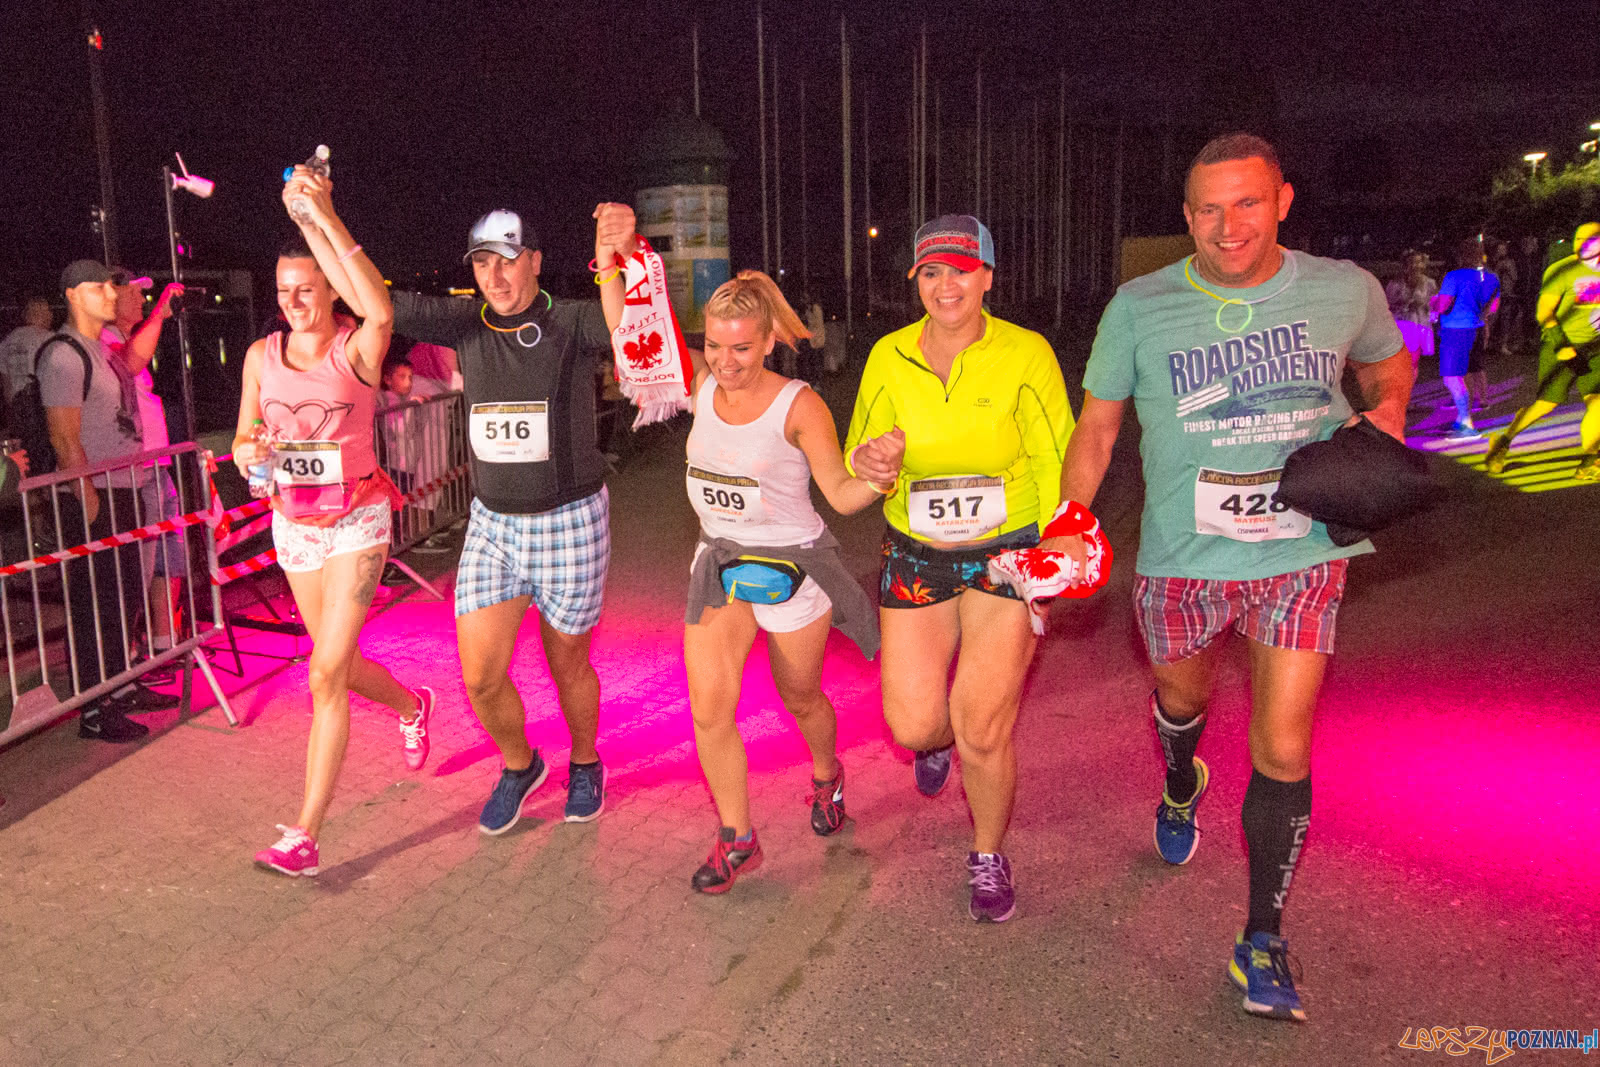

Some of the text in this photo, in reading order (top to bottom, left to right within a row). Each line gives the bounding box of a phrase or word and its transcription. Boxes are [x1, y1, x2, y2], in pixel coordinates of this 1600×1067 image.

[1168, 319, 1312, 396] ROADSIDE
[1231, 349, 1338, 397] MOMENTS
[485, 420, 530, 440] 516
[1183, 419, 1217, 433] FINEST
[1218, 415, 1252, 431] MOTOR
[1254, 411, 1291, 428] RACING
[1211, 437, 1237, 448] BREAK
[1253, 432, 1277, 443] SPEED
[282, 458, 325, 476] 430
[703, 487, 745, 511] 509
[928, 495, 984, 520] 517
[1219, 493, 1291, 516] 428
[935, 519, 980, 527] KATARZYNA
[1233, 514, 1277, 524] MATEUSZ
[1272, 814, 1311, 910] Kalenji
